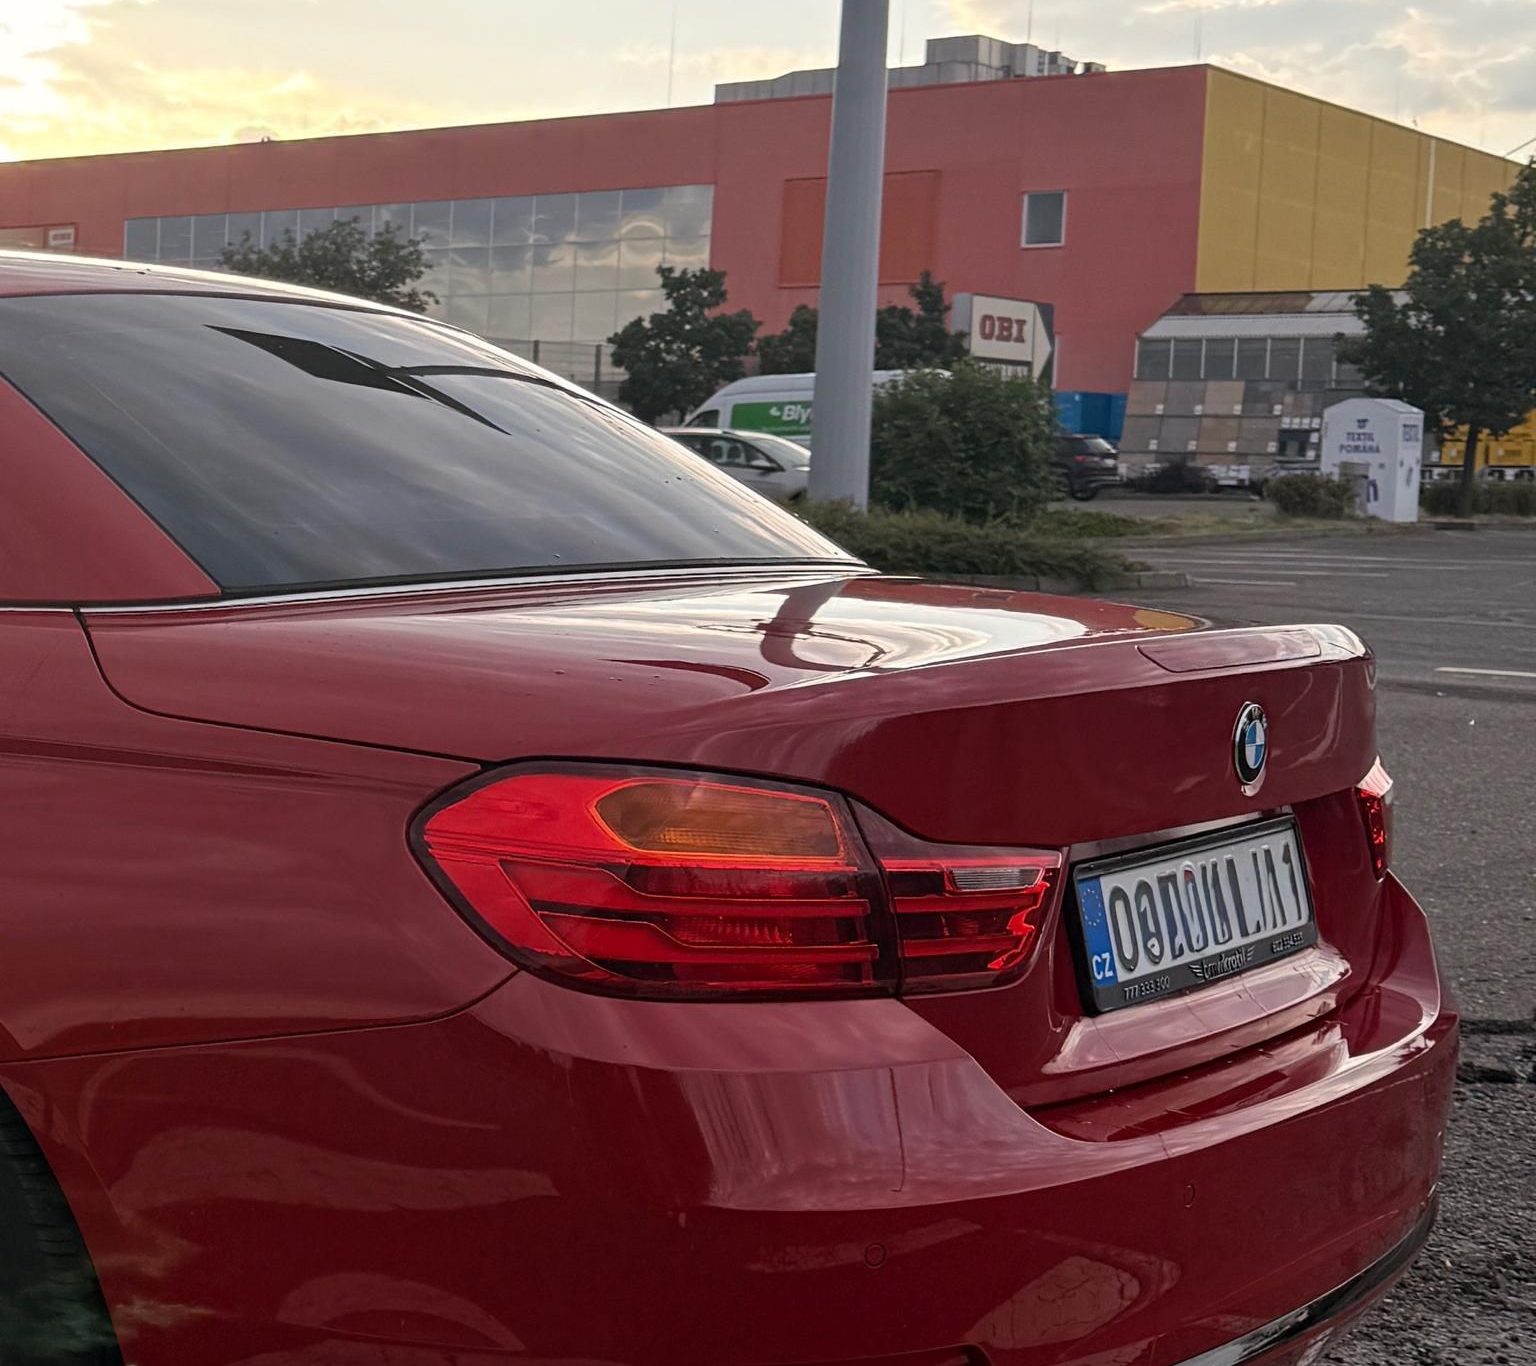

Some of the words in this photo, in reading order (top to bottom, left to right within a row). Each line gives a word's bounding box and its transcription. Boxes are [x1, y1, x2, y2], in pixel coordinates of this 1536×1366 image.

[979, 314, 1027, 344] OBI
[781, 403, 814, 425] Bly
[1092, 951, 1114, 980] CZ
[1124, 985, 1139, 1001] 777
